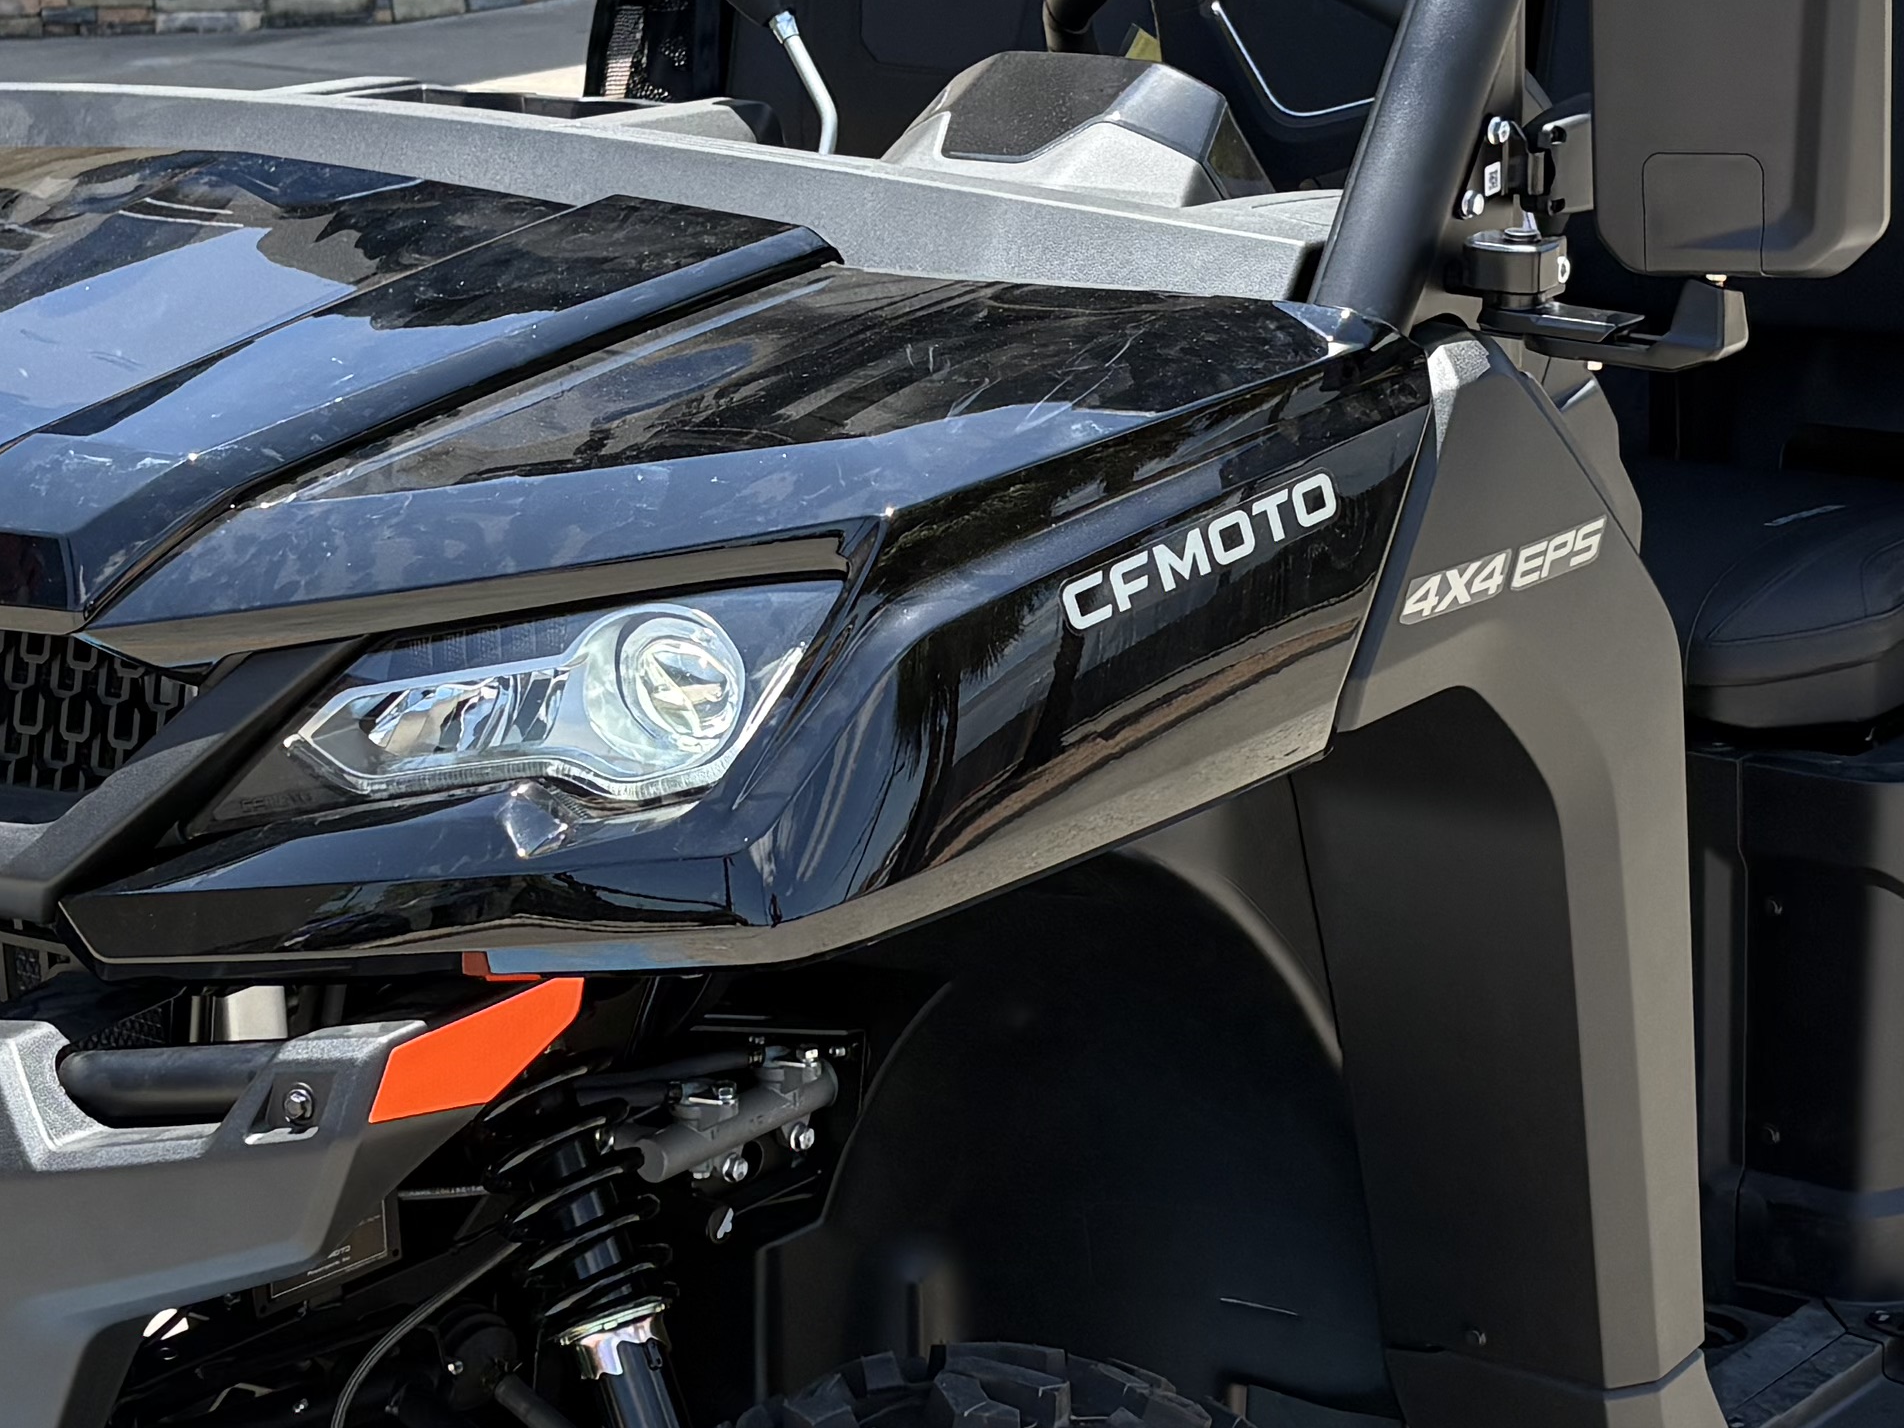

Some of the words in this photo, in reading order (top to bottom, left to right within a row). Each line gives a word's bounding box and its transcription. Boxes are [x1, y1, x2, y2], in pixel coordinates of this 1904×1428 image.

[1063, 473, 1339, 630] CFMOTO
[1405, 566, 1504, 617] 4X4
[1513, 519, 1606, 587] EPS
